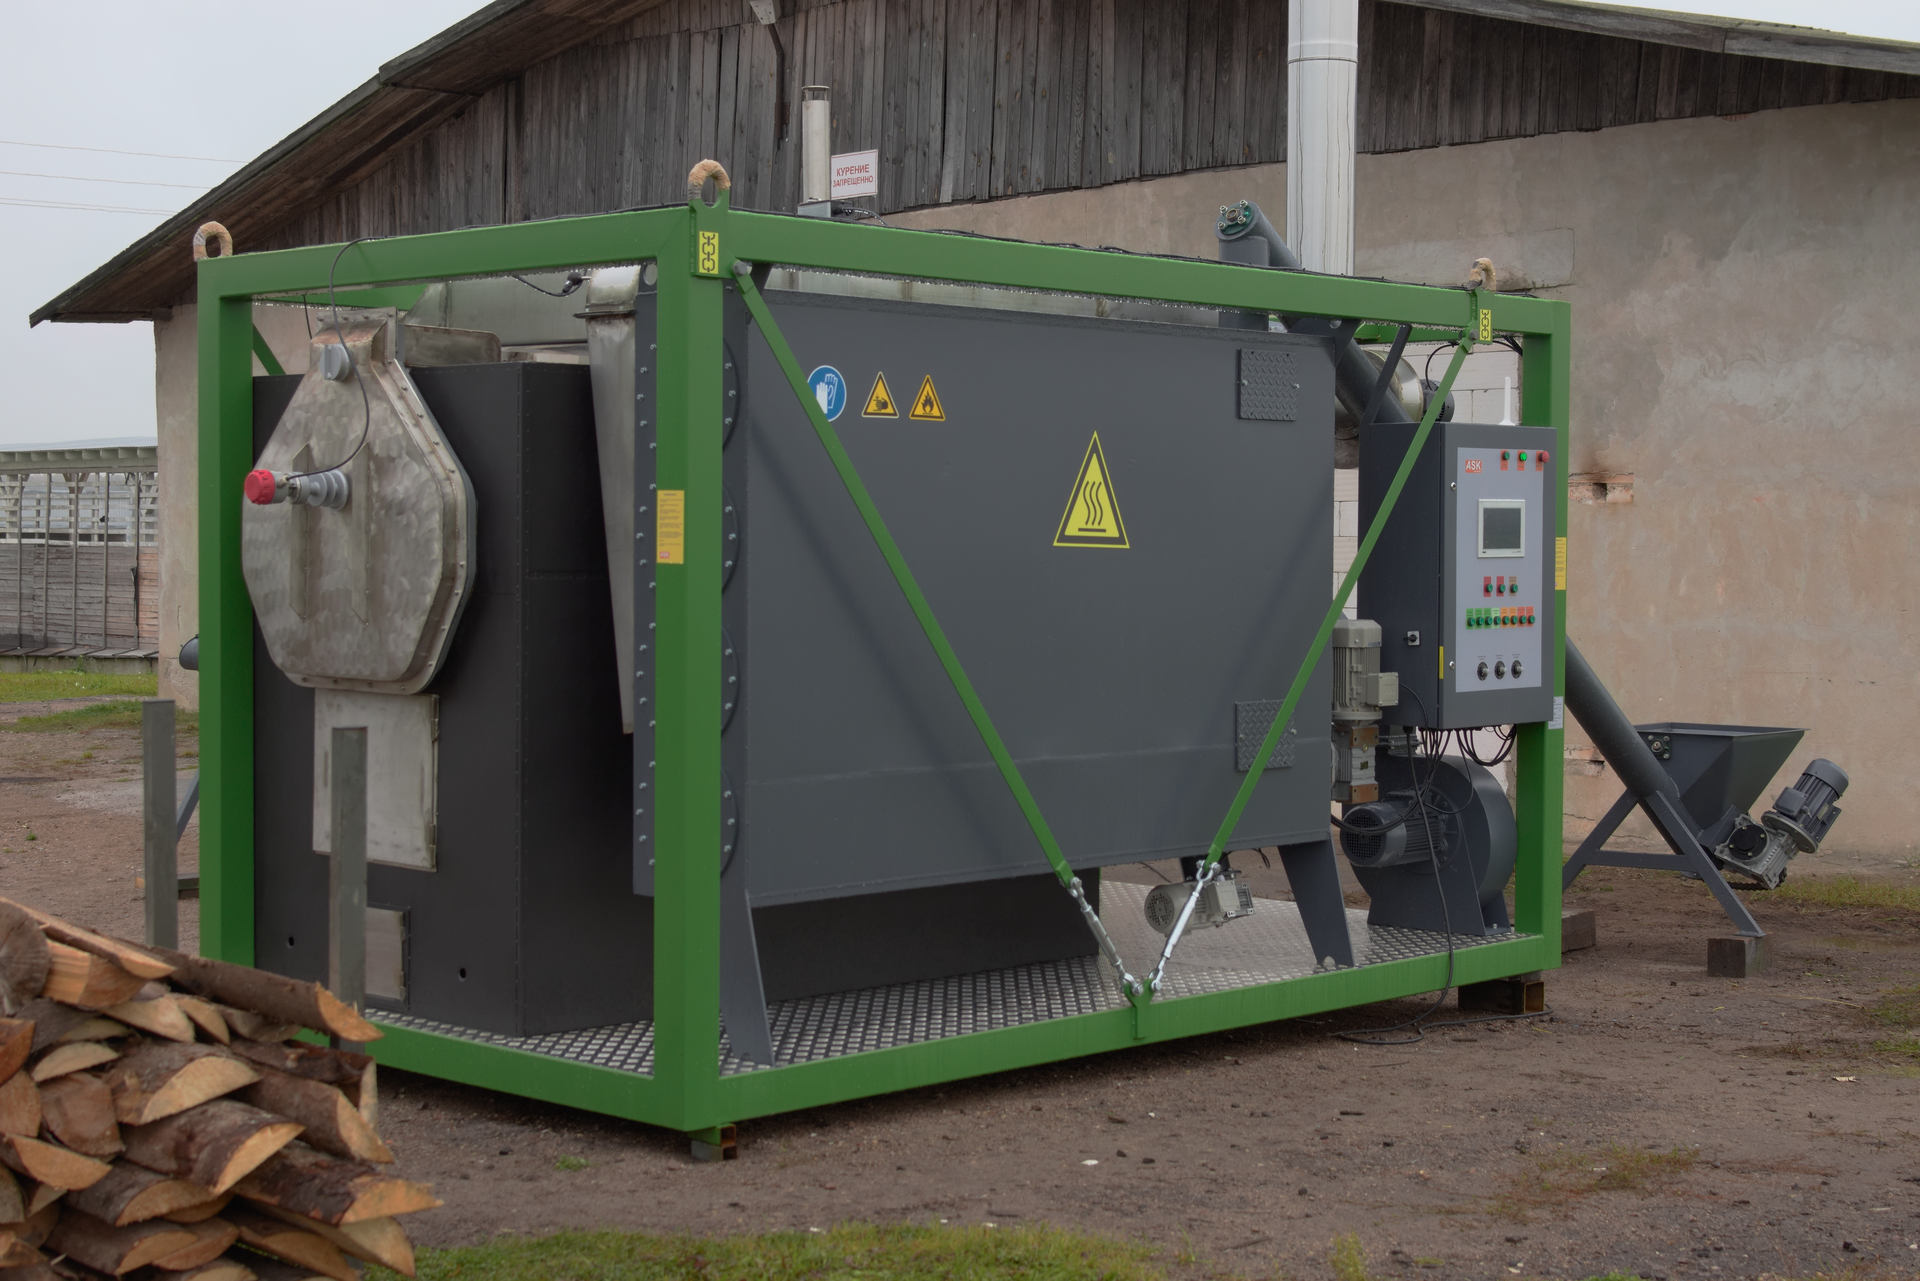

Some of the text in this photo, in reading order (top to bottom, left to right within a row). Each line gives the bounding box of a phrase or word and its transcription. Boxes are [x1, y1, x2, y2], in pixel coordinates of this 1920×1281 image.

[836, 163, 870, 176] КУРЕНИЕ
[833, 175, 874, 188] ЗАПРЕЩЕННО
[1465, 460, 1481, 470] ASK
